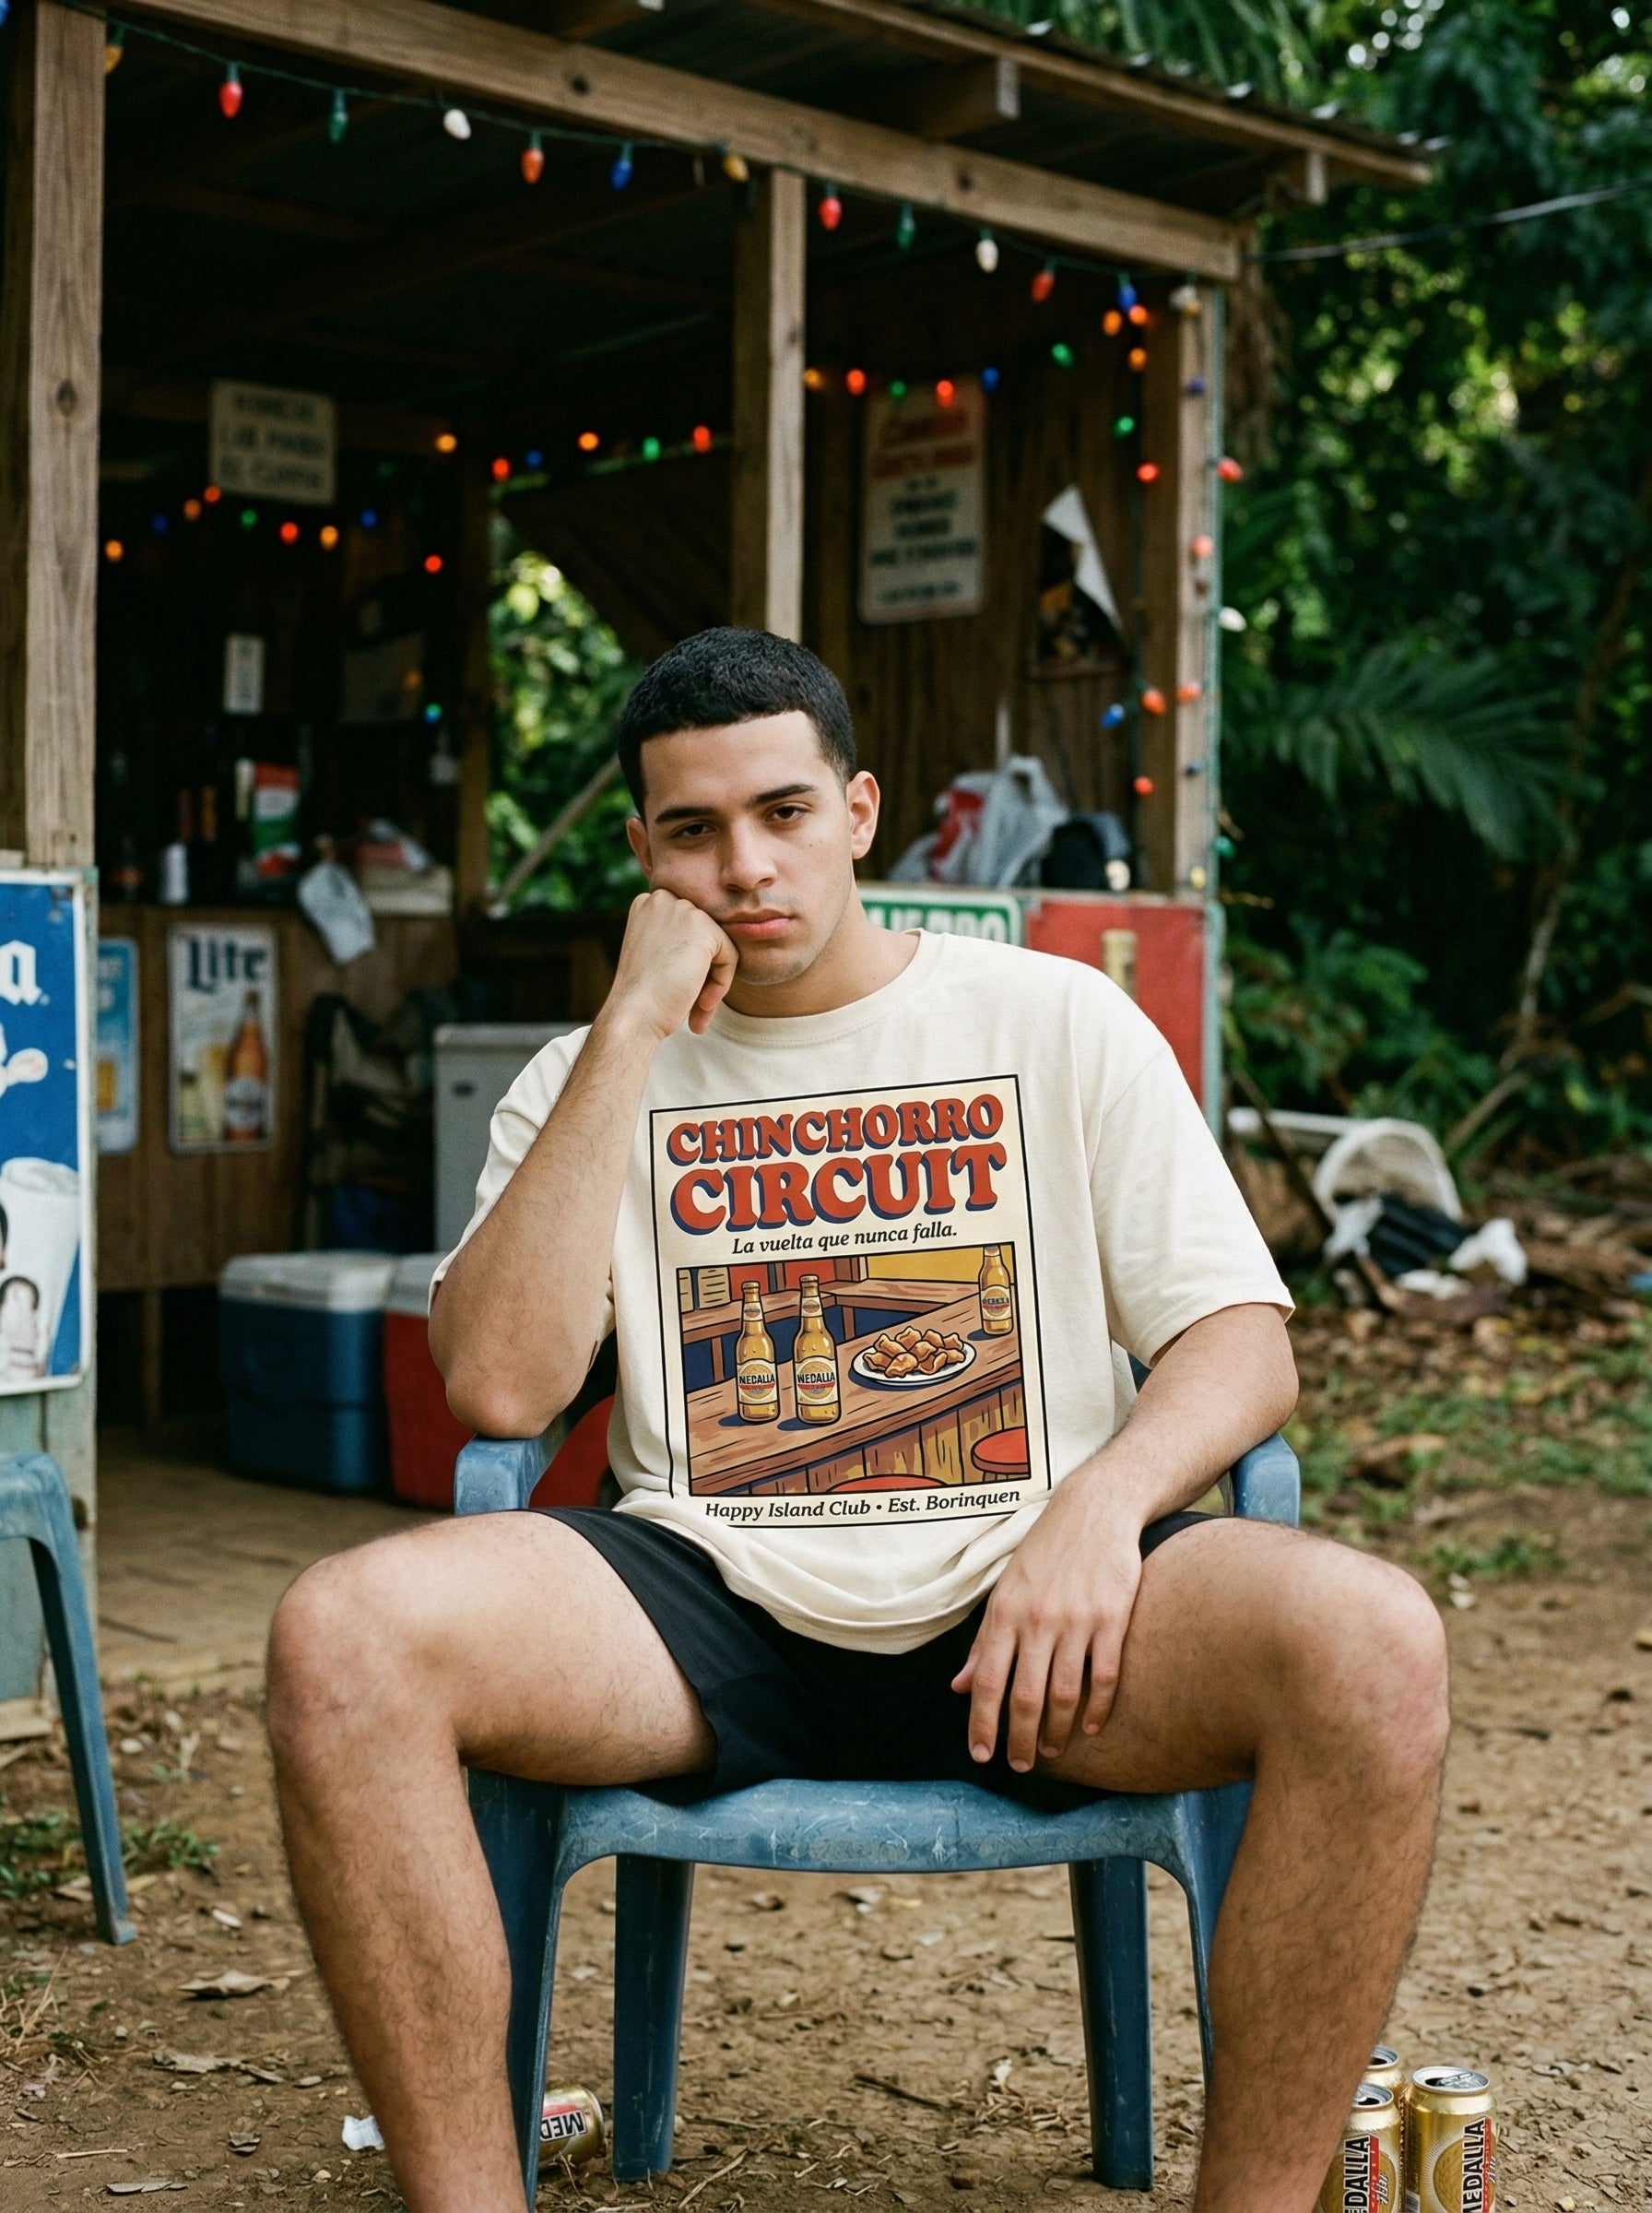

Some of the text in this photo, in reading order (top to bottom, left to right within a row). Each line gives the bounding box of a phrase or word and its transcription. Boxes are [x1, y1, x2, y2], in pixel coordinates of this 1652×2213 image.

[667, 1094, 1004, 1166] CHINCHORRO
[670, 1142, 1007, 1236] CIRCUIT
[732, 1221, 958, 1254] La vuelta que nunca falla.
[705, 1489, 1021, 1521] Happy Island Club Est. Borinquen
